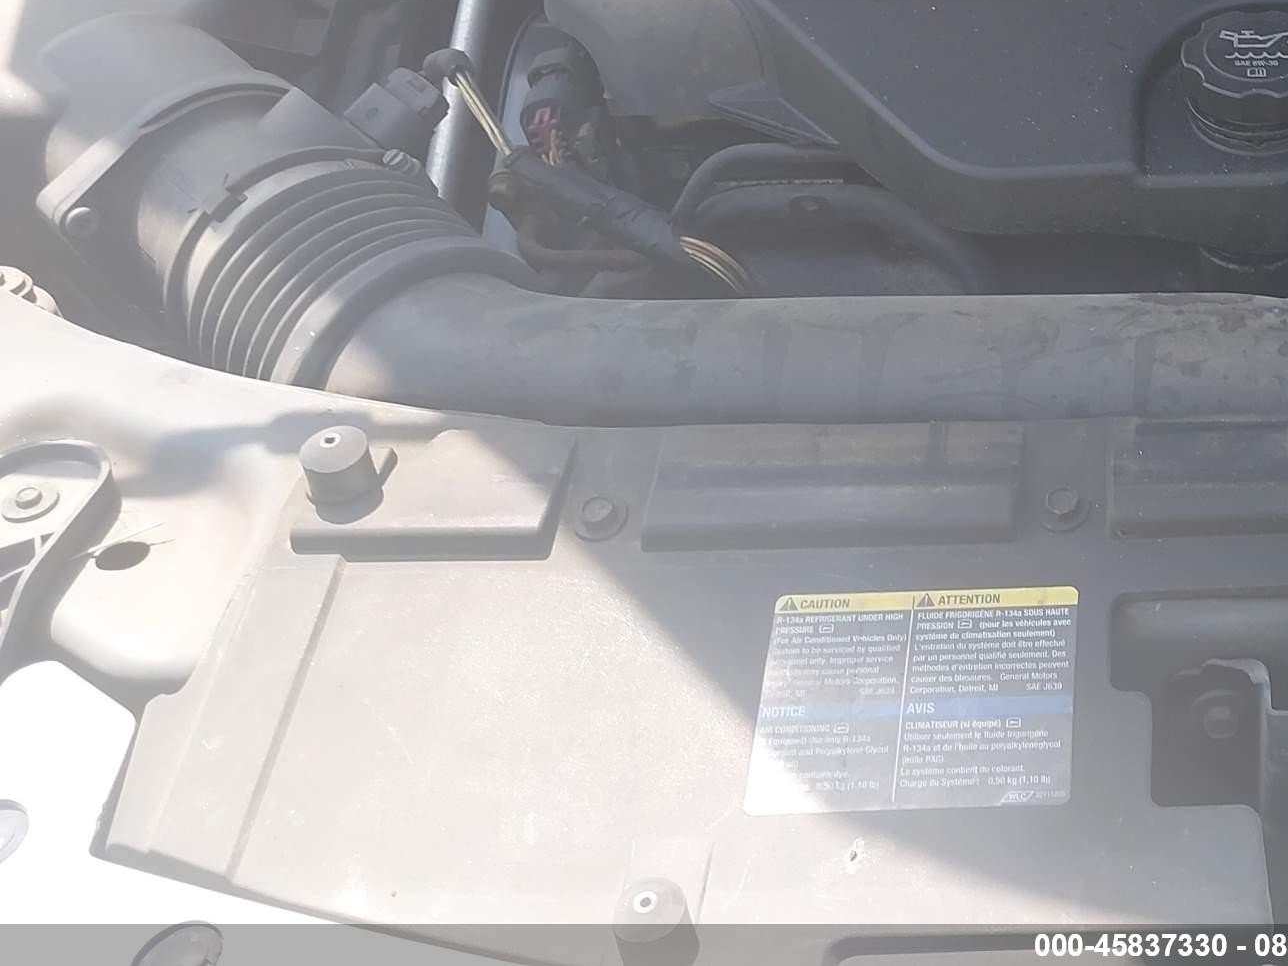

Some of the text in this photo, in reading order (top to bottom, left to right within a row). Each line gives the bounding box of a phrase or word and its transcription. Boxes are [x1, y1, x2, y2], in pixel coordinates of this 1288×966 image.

[800, 599, 850, 609] CAUTION
[938, 594, 1000, 605] ATTENTION
[946, 609, 993, 618] FRIGORIGÈNE
[996, 610, 1022, 618] R-134a
[1024, 608, 1043, 617] SOUS
[777, 616, 803, 624] R-134a
[980, 621, 1000, 629] (pour
[1015, 619, 1051, 627] véhicules
[1053, 618, 1071, 626] avec
[776, 626, 813, 634] PRESSURE
[916, 633, 947, 641] système
[962, 631, 1010, 639] climatisation
[1013, 629, 1055, 637] seulement)
[774, 637, 789, 645] (For
[968, 641, 999, 650] système
[913, 654, 925, 662] par
[939, 652, 976, 661] personnel
[1039, 660, 1069, 669] peuvent
[939, 674, 952, 682] des
[1000, 673, 1029, 681] General
[958, 683, 985, 692] Detroit,
[989, 683, 998, 691] MI
[762, 706, 805, 718] NOTICE
[906, 703, 935, 714] AVIS
[906, 720, 1001, 729] CLIMATISEUR (si équipé)
[905, 733, 931, 741] Utiliser
[933, 732, 972, 740] seulement
[903, 744, 930, 752] R-134a
[916, 767, 944, 776] système
[946, 766, 978, 774] contient
[900, 779, 927, 788] Charge
[929, 779, 939, 787] du
[1008, 777, 1017, 786] kg
